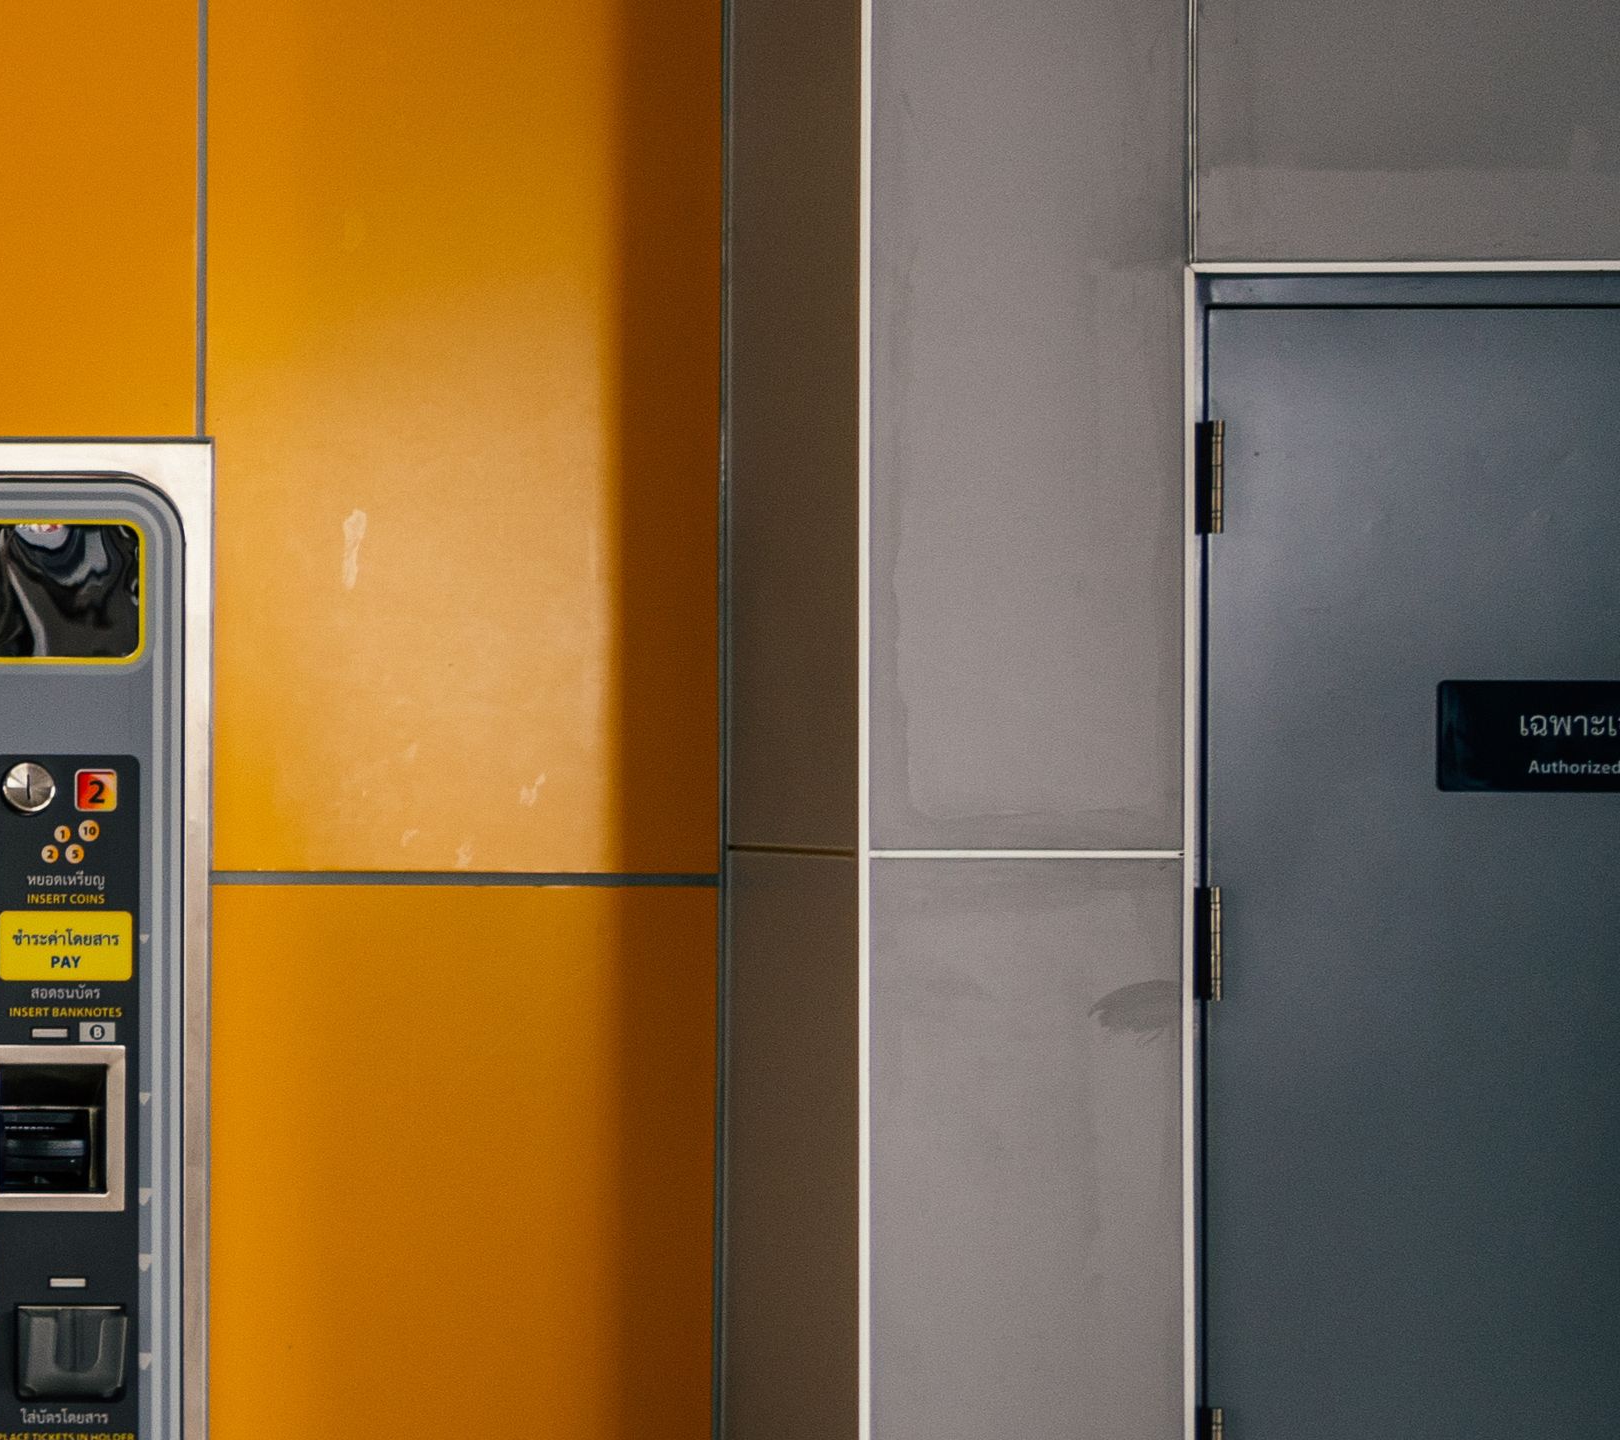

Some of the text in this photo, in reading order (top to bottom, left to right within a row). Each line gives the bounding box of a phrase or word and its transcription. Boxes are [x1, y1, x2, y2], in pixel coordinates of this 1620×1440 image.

[1519, 714, 1620, 737] เฉพาะเ
[1528, 759, 1620, 775] Authorized
[88, 781, 105, 804] 2
[26, 872, 106, 890] หยอดเหรียญ
[26, 894, 105, 904] INSERT COINS
[12, 928, 120, 946] ชำระค่าโดยสาร
[50, 956, 82, 969] PAY
[31, 984, 101, 999] สอดธนบัตร
[9, 1007, 123, 1018] INSERT BANKNOTES
[19, 1407, 110, 1424] ใส่บัตรโดยสาร
